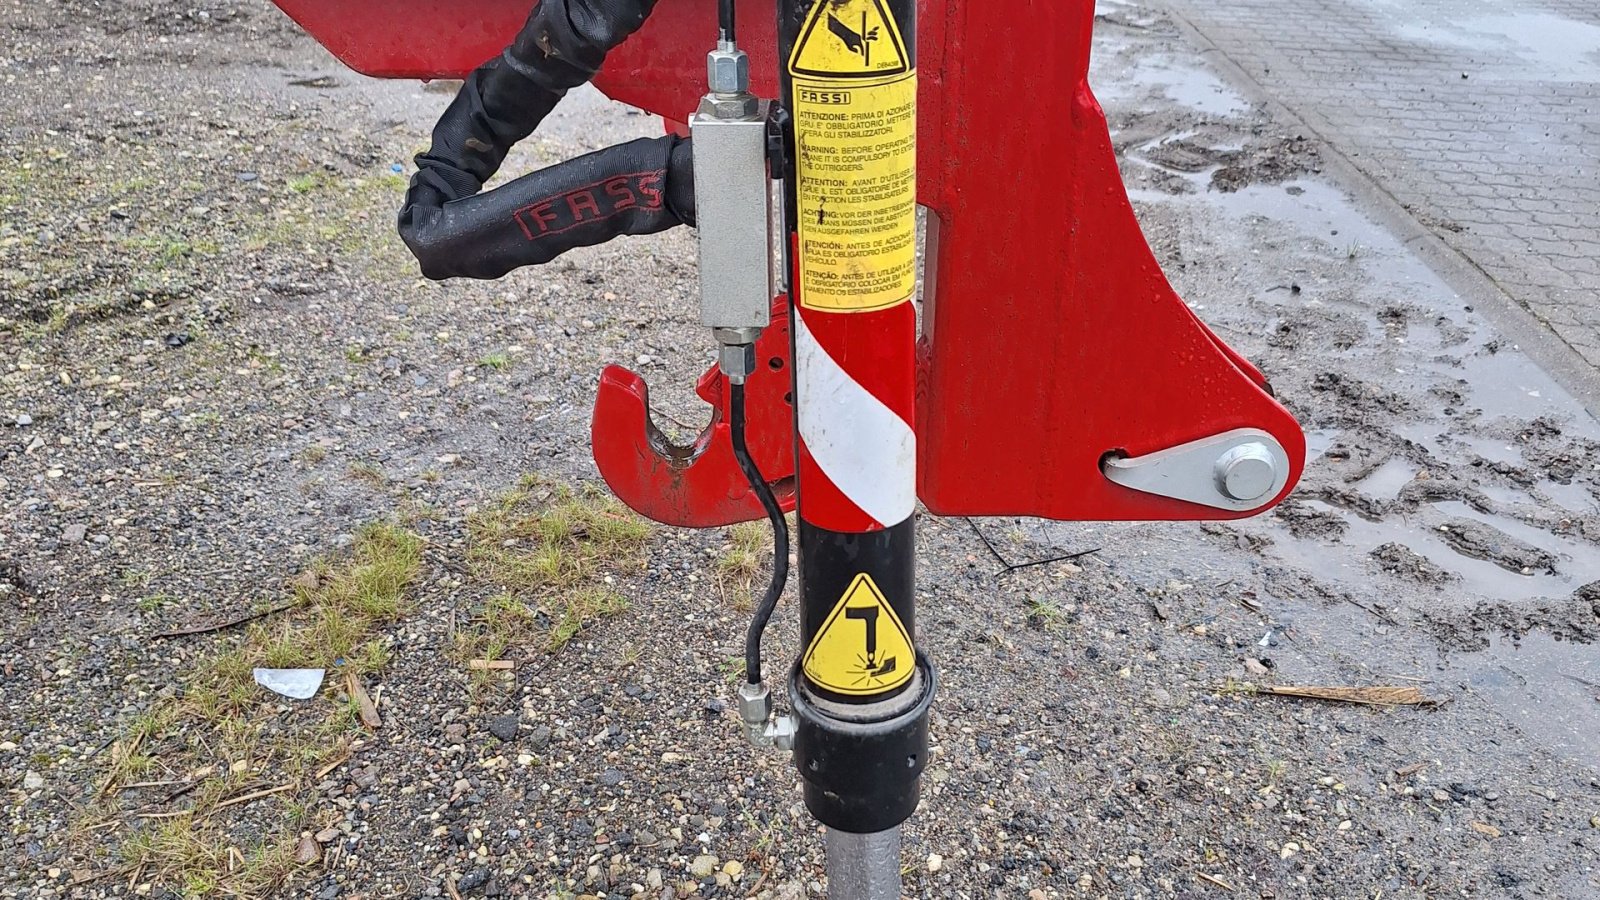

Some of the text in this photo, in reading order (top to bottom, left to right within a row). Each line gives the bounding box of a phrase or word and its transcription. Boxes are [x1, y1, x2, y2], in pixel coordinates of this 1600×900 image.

[802, 91, 847, 103] FASSI
[800, 111, 849, 121] ATTENZIONE:
[851, 112, 875, 120] PRIMA
[877, 110, 884, 118] DI
[826, 119, 884, 130] OBBLIGATORIO
[824, 131, 836, 139] GLI
[801, 143, 839, 155] WARNING:
[841, 145, 873, 155] BEFORE
[875, 137, 909, 151] OPERATING
[842, 152, 891, 163] COMPULSORY
[801, 176, 848, 187] ATTENTION:
[852, 177, 877, 186] AVANT
[830, 188, 843, 196] EST
[845, 183, 890, 196] OBLIGATOIRE
[529, 174, 663, 231] FASS
[812, 194, 847, 203] FOCTION
[848, 196, 861, 204] LES
[803, 208, 839, 219] ACHTNG:
[839, 211, 855, 220] VOR
[857, 210, 872, 219] DER
[817, 217, 840, 227] RANS
[818, 226, 870, 236] AUSGEFAHREN
[846, 240, 871, 250] ANTES
[873, 240, 883, 248] DE
[823, 250, 832, 258] ES
[834, 248, 880, 258] OBLIGATORIO
[866, 271, 875, 279] DE
[858, 276, 891, 288] COLOCAR
